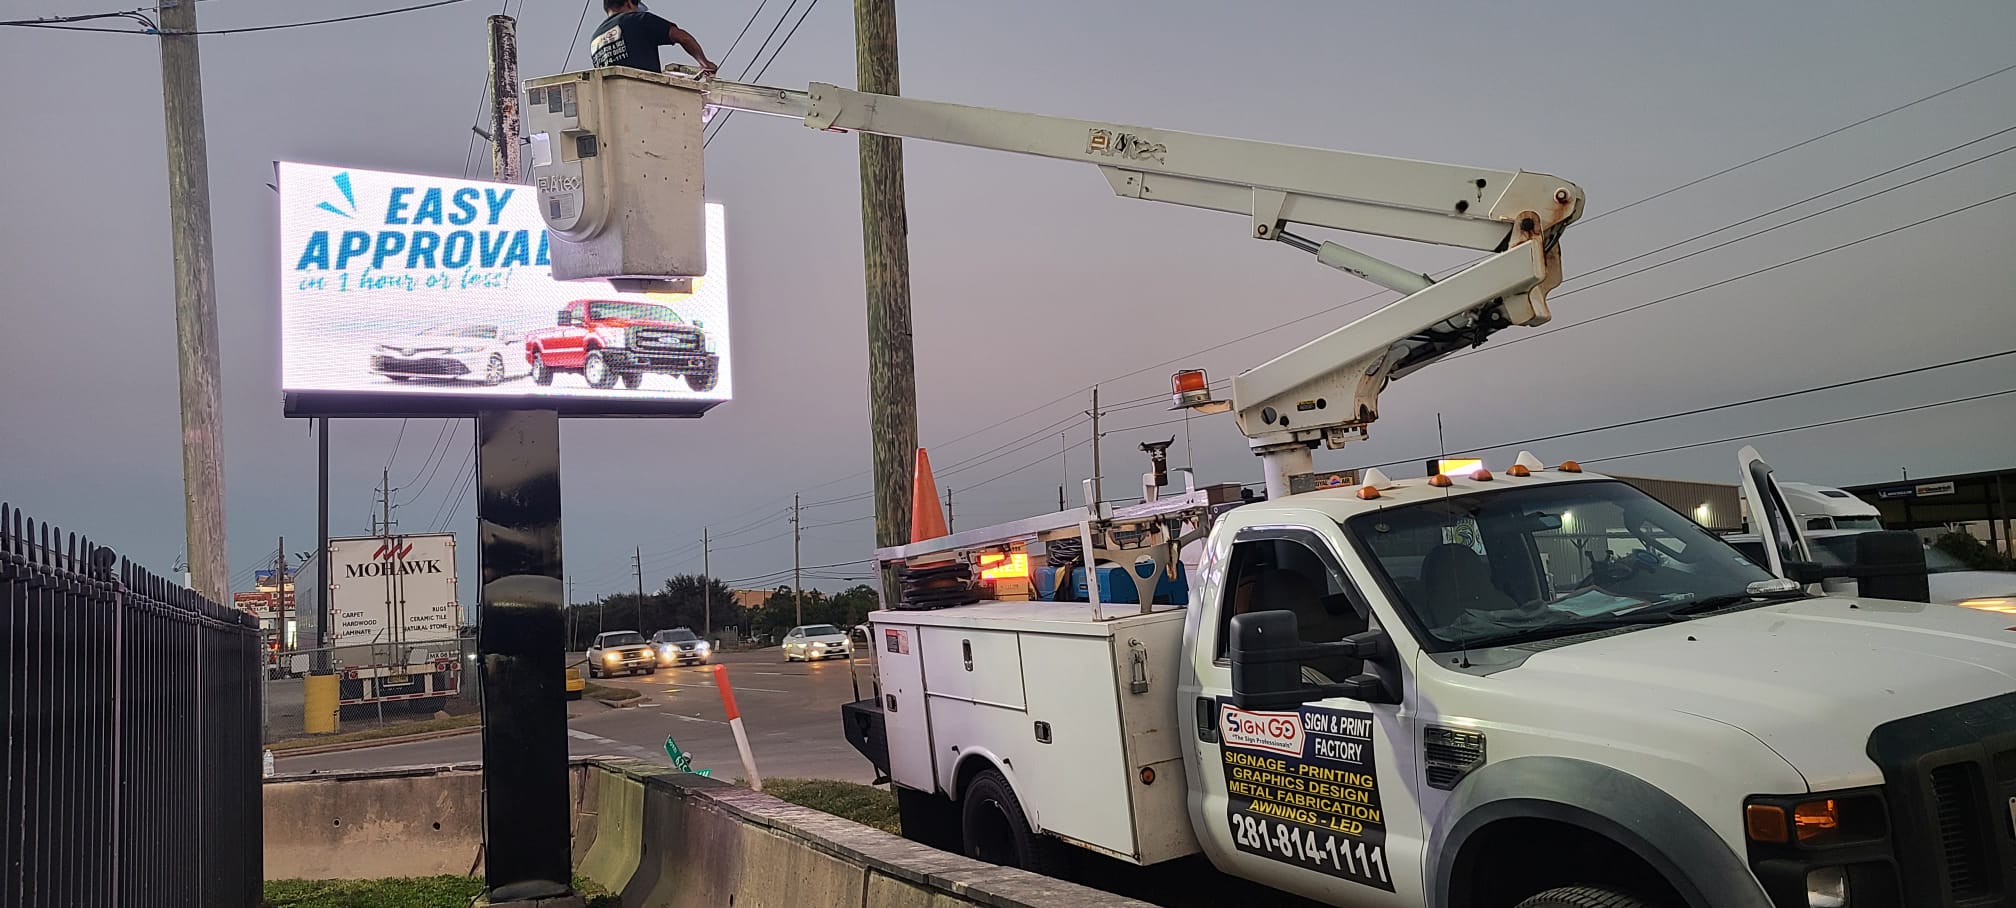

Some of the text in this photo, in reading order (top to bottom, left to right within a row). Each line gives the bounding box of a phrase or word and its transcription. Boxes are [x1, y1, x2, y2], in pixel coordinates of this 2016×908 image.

[385, 187, 516, 226] EASY
[299, 265, 513, 291] in 1 hour or less!
[345, 559, 442, 578] MOHAWK
[342, 611, 364, 619] CARPET
[1269, 718, 1296, 740] GO
[1304, 712, 1372, 738] SIGN & PRINT
[1315, 737, 1363, 761] FACTORY
[1225, 751, 1287, 772] SIGNAGE
[1299, 764, 1374, 788] PRINTING
[1233, 768, 1369, 804] GRAPHICS DESIGN
[1229, 781, 1380, 822] METAL FABRICATION
[1249, 800, 1318, 824] AWNINGS
[1330, 817, 1363, 834] LED
[1232, 814, 1388, 883] 281-814-1111
